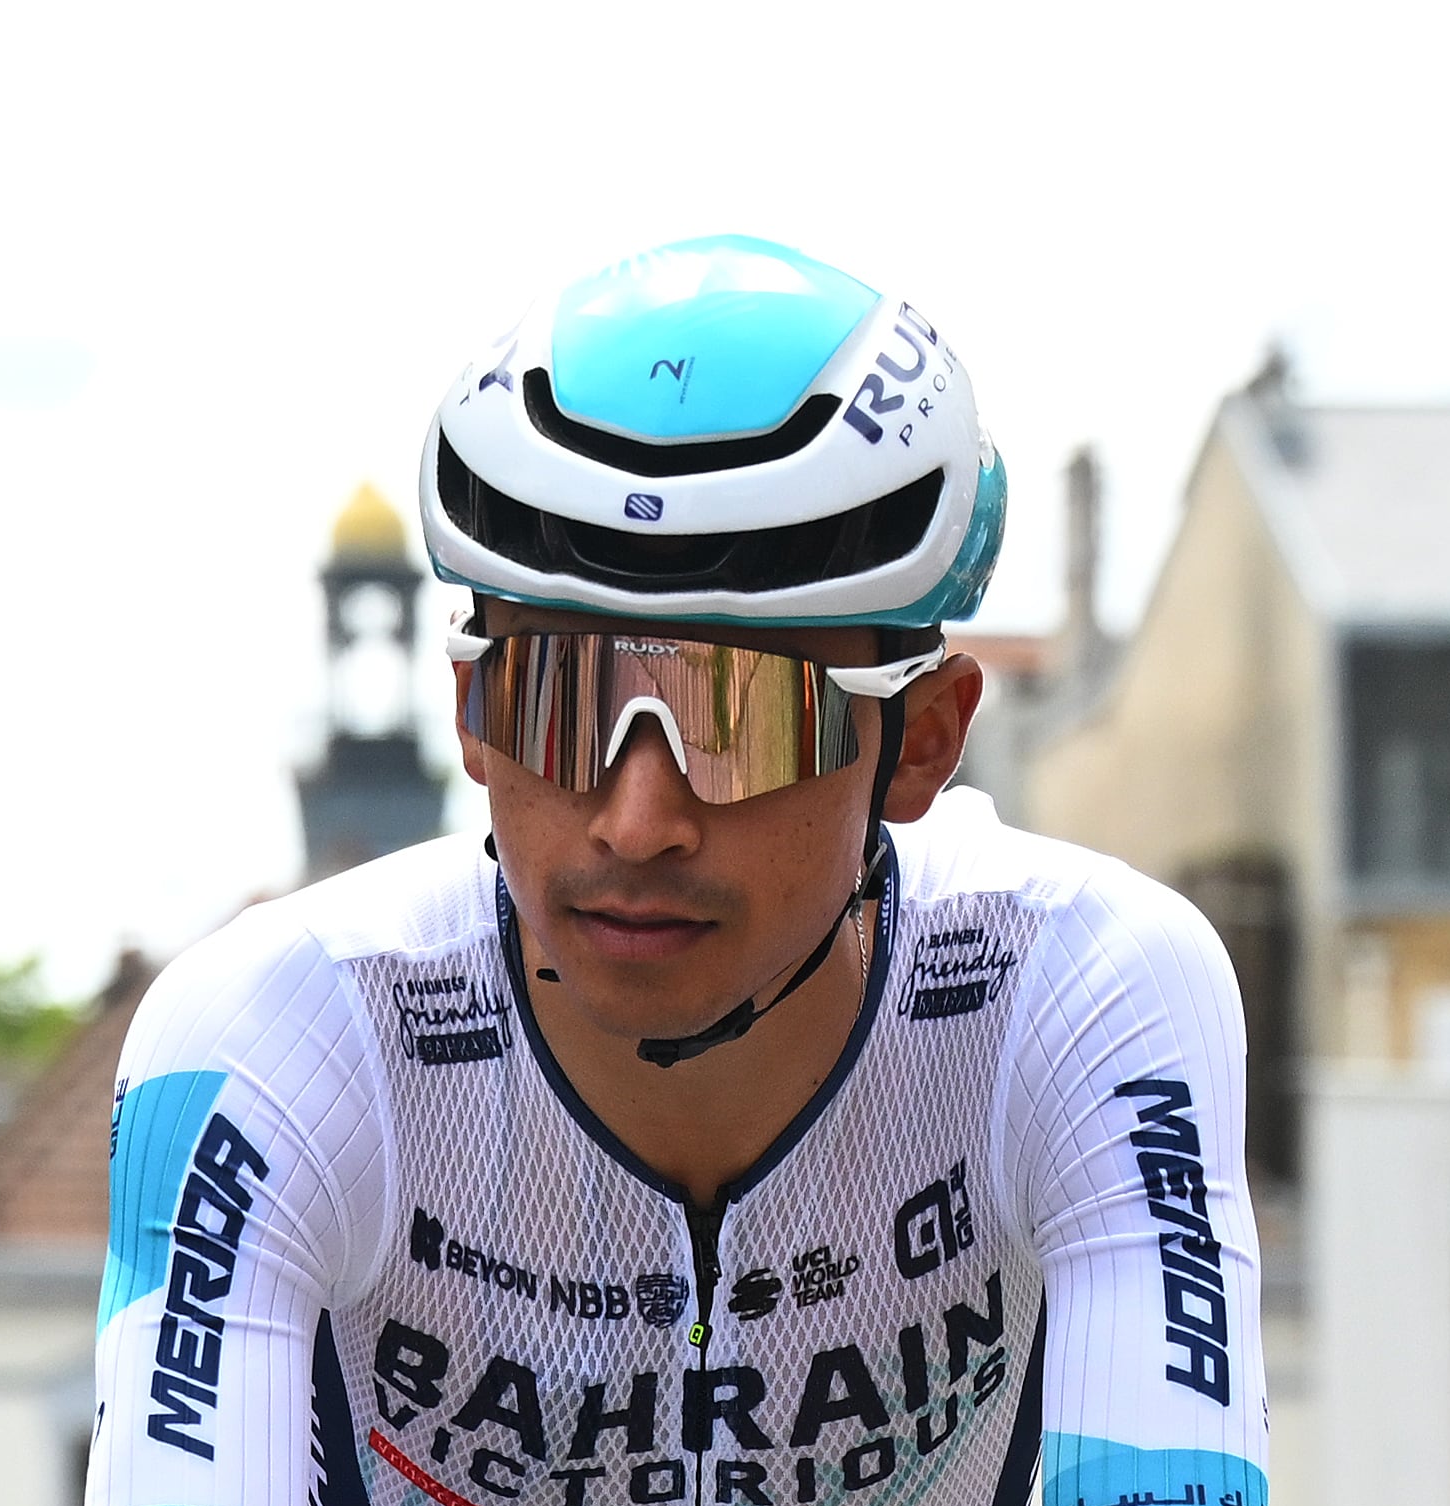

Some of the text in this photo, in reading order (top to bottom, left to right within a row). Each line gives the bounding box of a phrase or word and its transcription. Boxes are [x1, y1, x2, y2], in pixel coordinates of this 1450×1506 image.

[614, 641, 679, 656] RUDY
[928, 927, 984, 949] BUSINESS
[898, 935, 1018, 1016] friendly
[393, 980, 513, 1060] friendly
[445, 1239, 537, 1300] BEYON
[792, 1246, 831, 1272] UCI
[1114, 1078, 1231, 1409] MERIDA
[147, 1111, 271, 1463] MERIDA
[550, 1275, 630, 1320] NBB
[792, 1256, 861, 1291] WORLD
[793, 1280, 845, 1309] TEAM
[372, 1269, 1004, 1460] BAHRAIN
